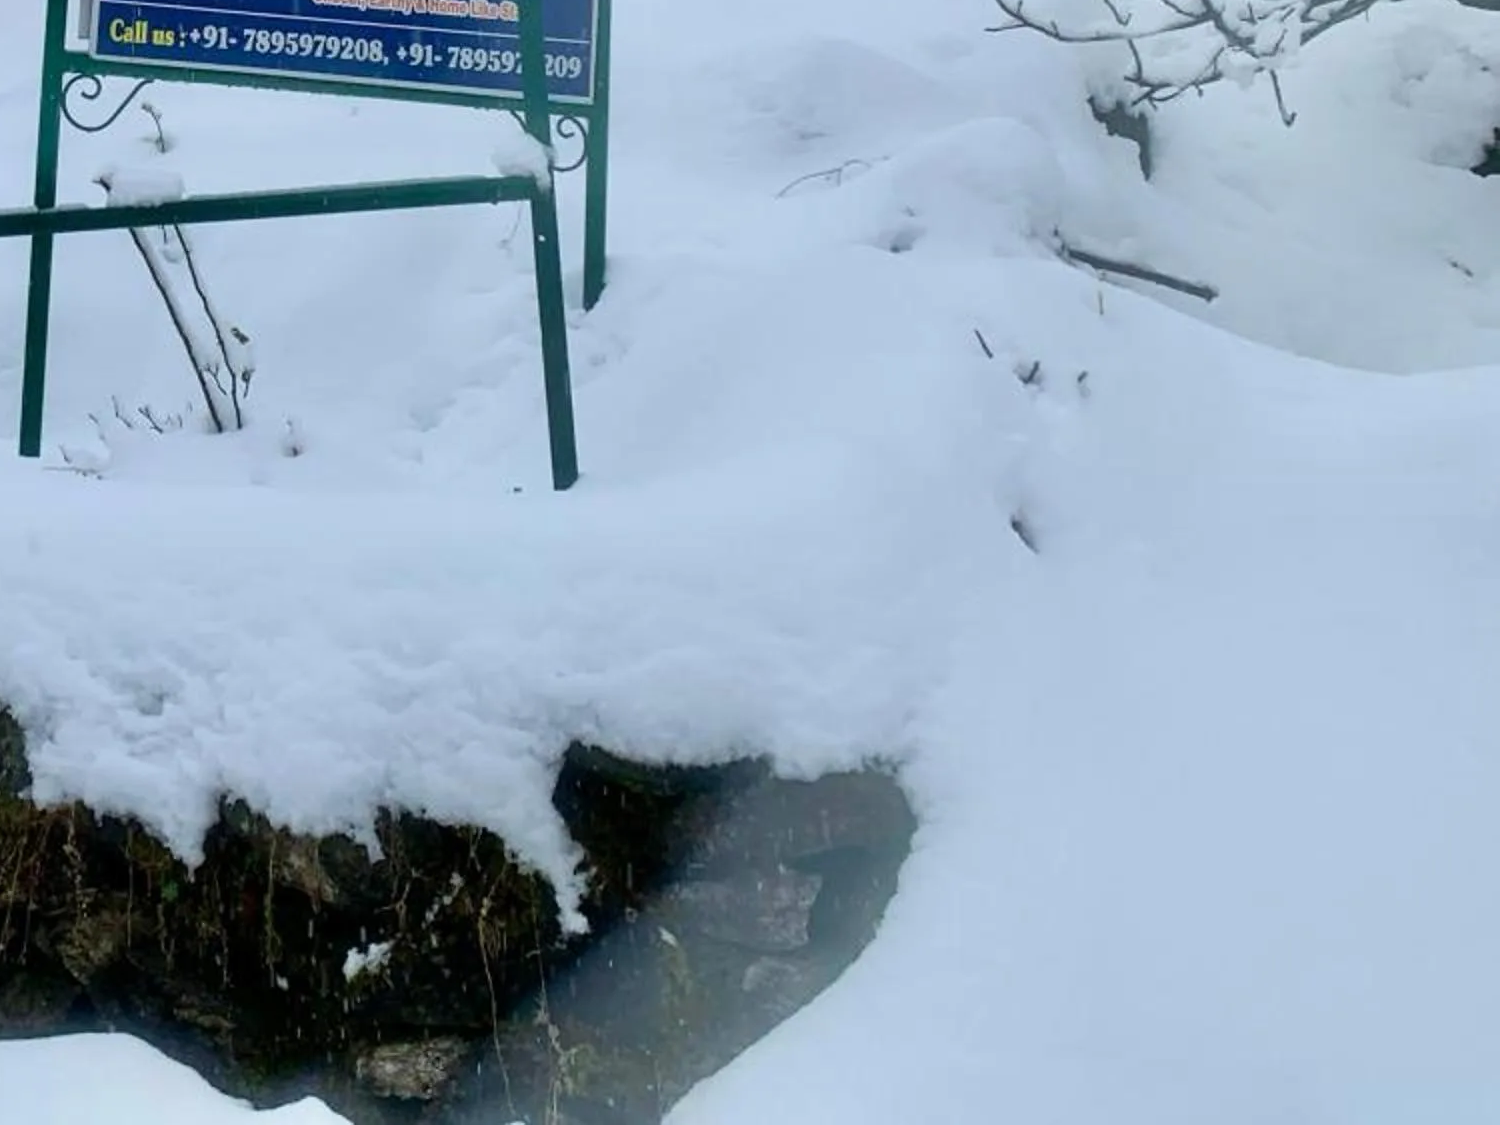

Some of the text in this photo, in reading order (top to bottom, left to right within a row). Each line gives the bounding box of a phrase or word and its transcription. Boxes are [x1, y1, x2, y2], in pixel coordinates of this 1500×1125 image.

[499, 0, 519, 22] St
[109, 18, 148, 44] Call
[151, 29, 175, 47] us
[243, 28, 389, 65] 7895979208,
[396, 42, 442, 68] +91-
[447, 45, 582, 79] 789597209
